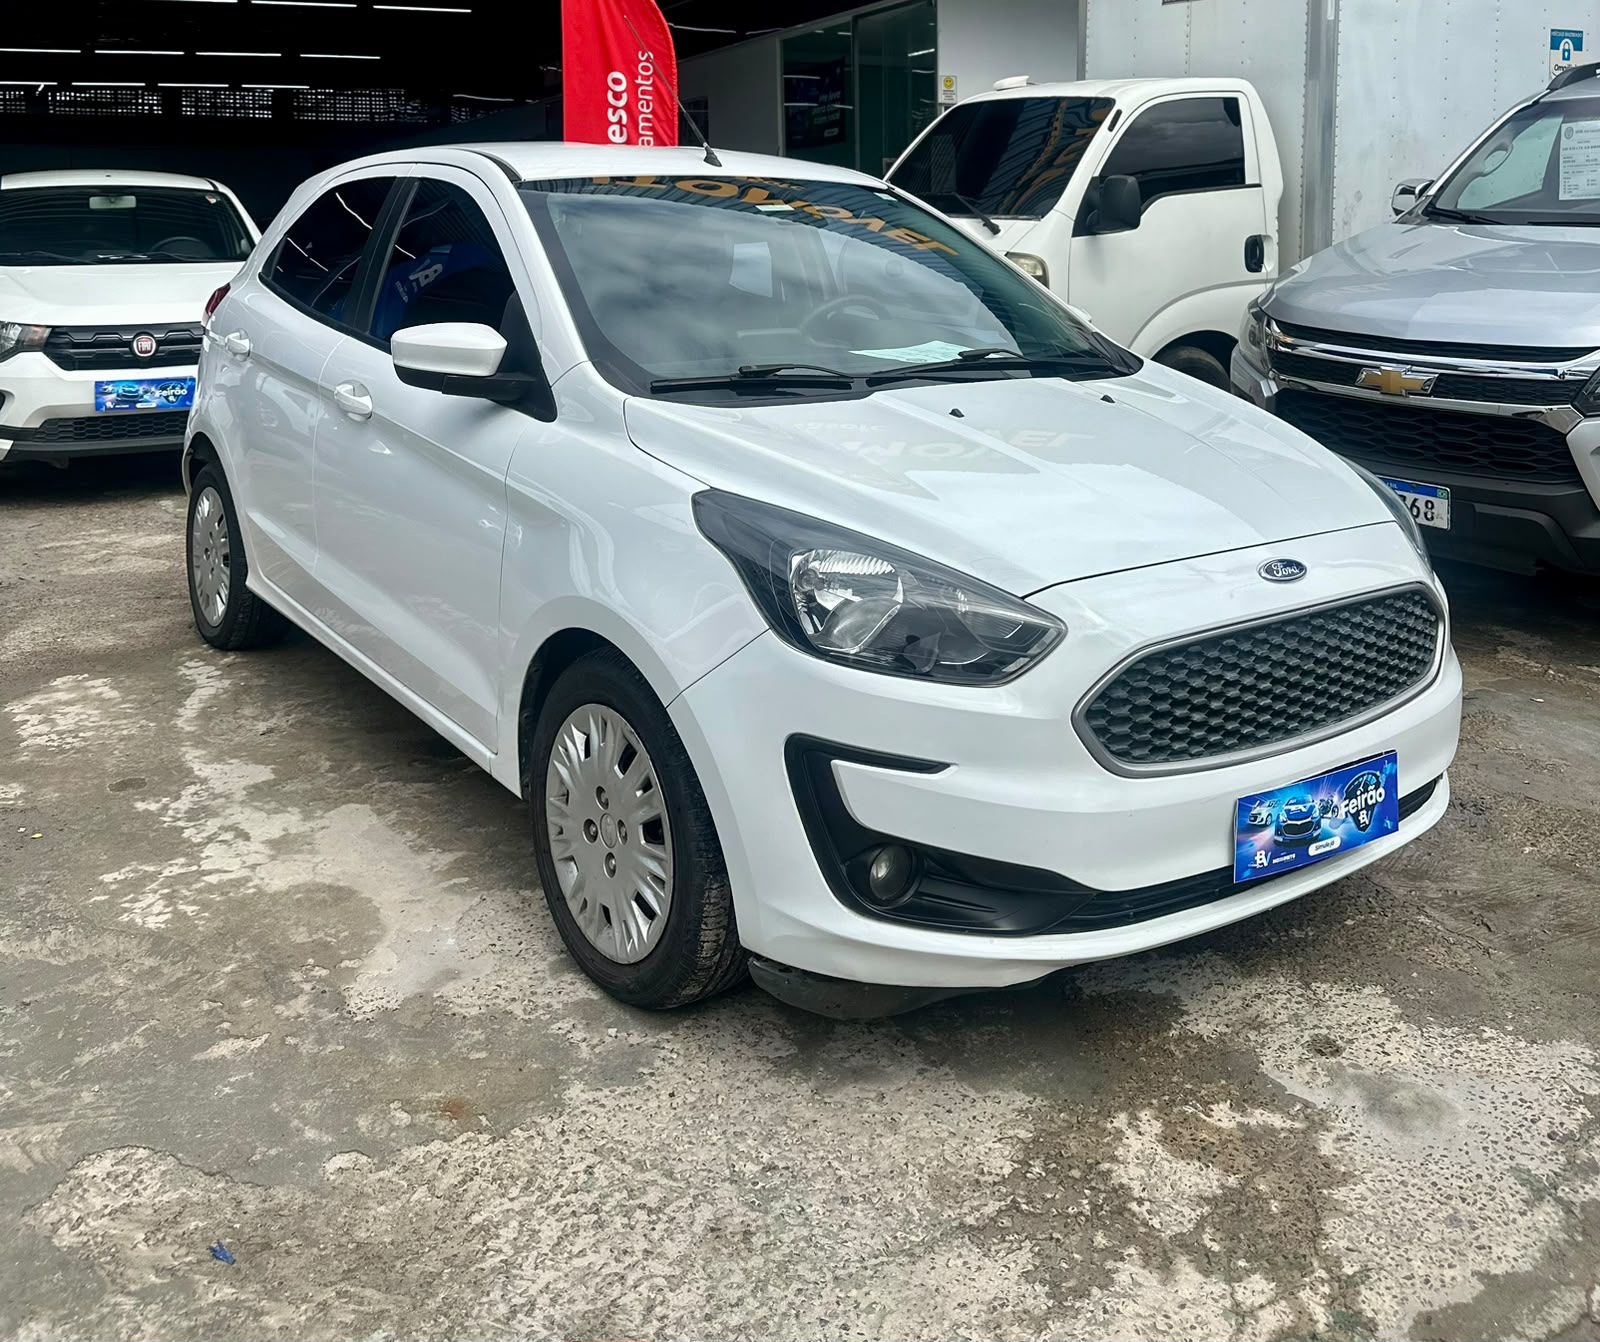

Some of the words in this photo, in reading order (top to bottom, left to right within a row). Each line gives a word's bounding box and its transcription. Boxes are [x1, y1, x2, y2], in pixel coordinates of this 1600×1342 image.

[155, 387, 188, 398] Feirão
[1271, 561, 1300, 577] Ford
[1340, 784, 1386, 820] Feirão
